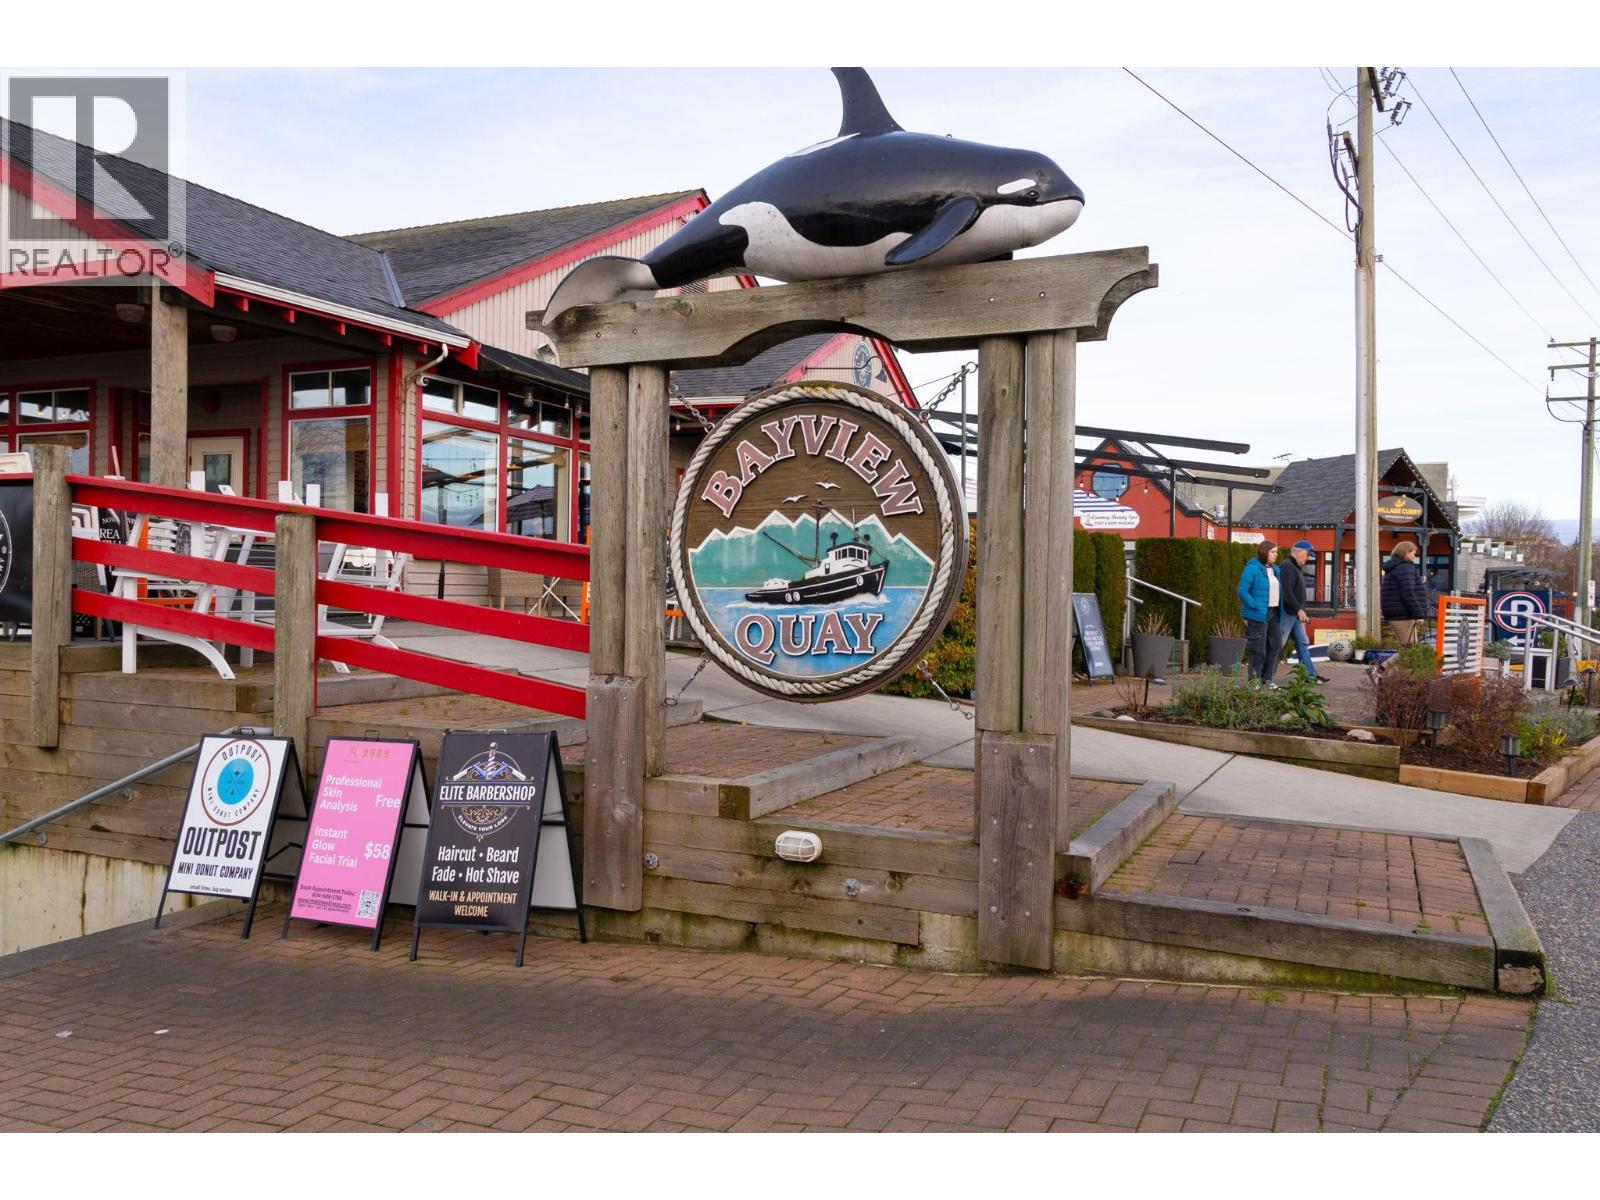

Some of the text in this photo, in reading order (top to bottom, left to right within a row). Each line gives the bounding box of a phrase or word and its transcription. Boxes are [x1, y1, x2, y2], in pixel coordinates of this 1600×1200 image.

[701, 414, 924, 519] BAYVIEW
[735, 611, 884, 666] QUAY
[222, 744, 262, 762] OUTPOST
[326, 775, 382, 789] Professional
[322, 786, 342, 798] Skin
[440, 785, 536, 802] ELITE BARBERSHOP
[320, 799, 358, 813] Analysis
[375, 794, 401, 808] Free
[457, 814, 478, 832] ELEVATE
[494, 815, 508, 828] LOOK
[315, 826, 348, 839] Instant
[183, 826, 262, 860] OUTPOST
[312, 840, 335, 851] Glow
[363, 840, 391, 860] $58
[309, 853, 358, 868] Facial Trial
[438, 845, 519, 863] Haircut Beard
[178, 861, 253, 880] MINI DONUT COMPANY
[432, 866, 520, 884] Fade Hot Shave
[312, 885, 341, 894] Appointment
[428, 890, 517, 904] WALK-IN & APPOINTMENT
[454, 905, 489, 917] WELCOME
